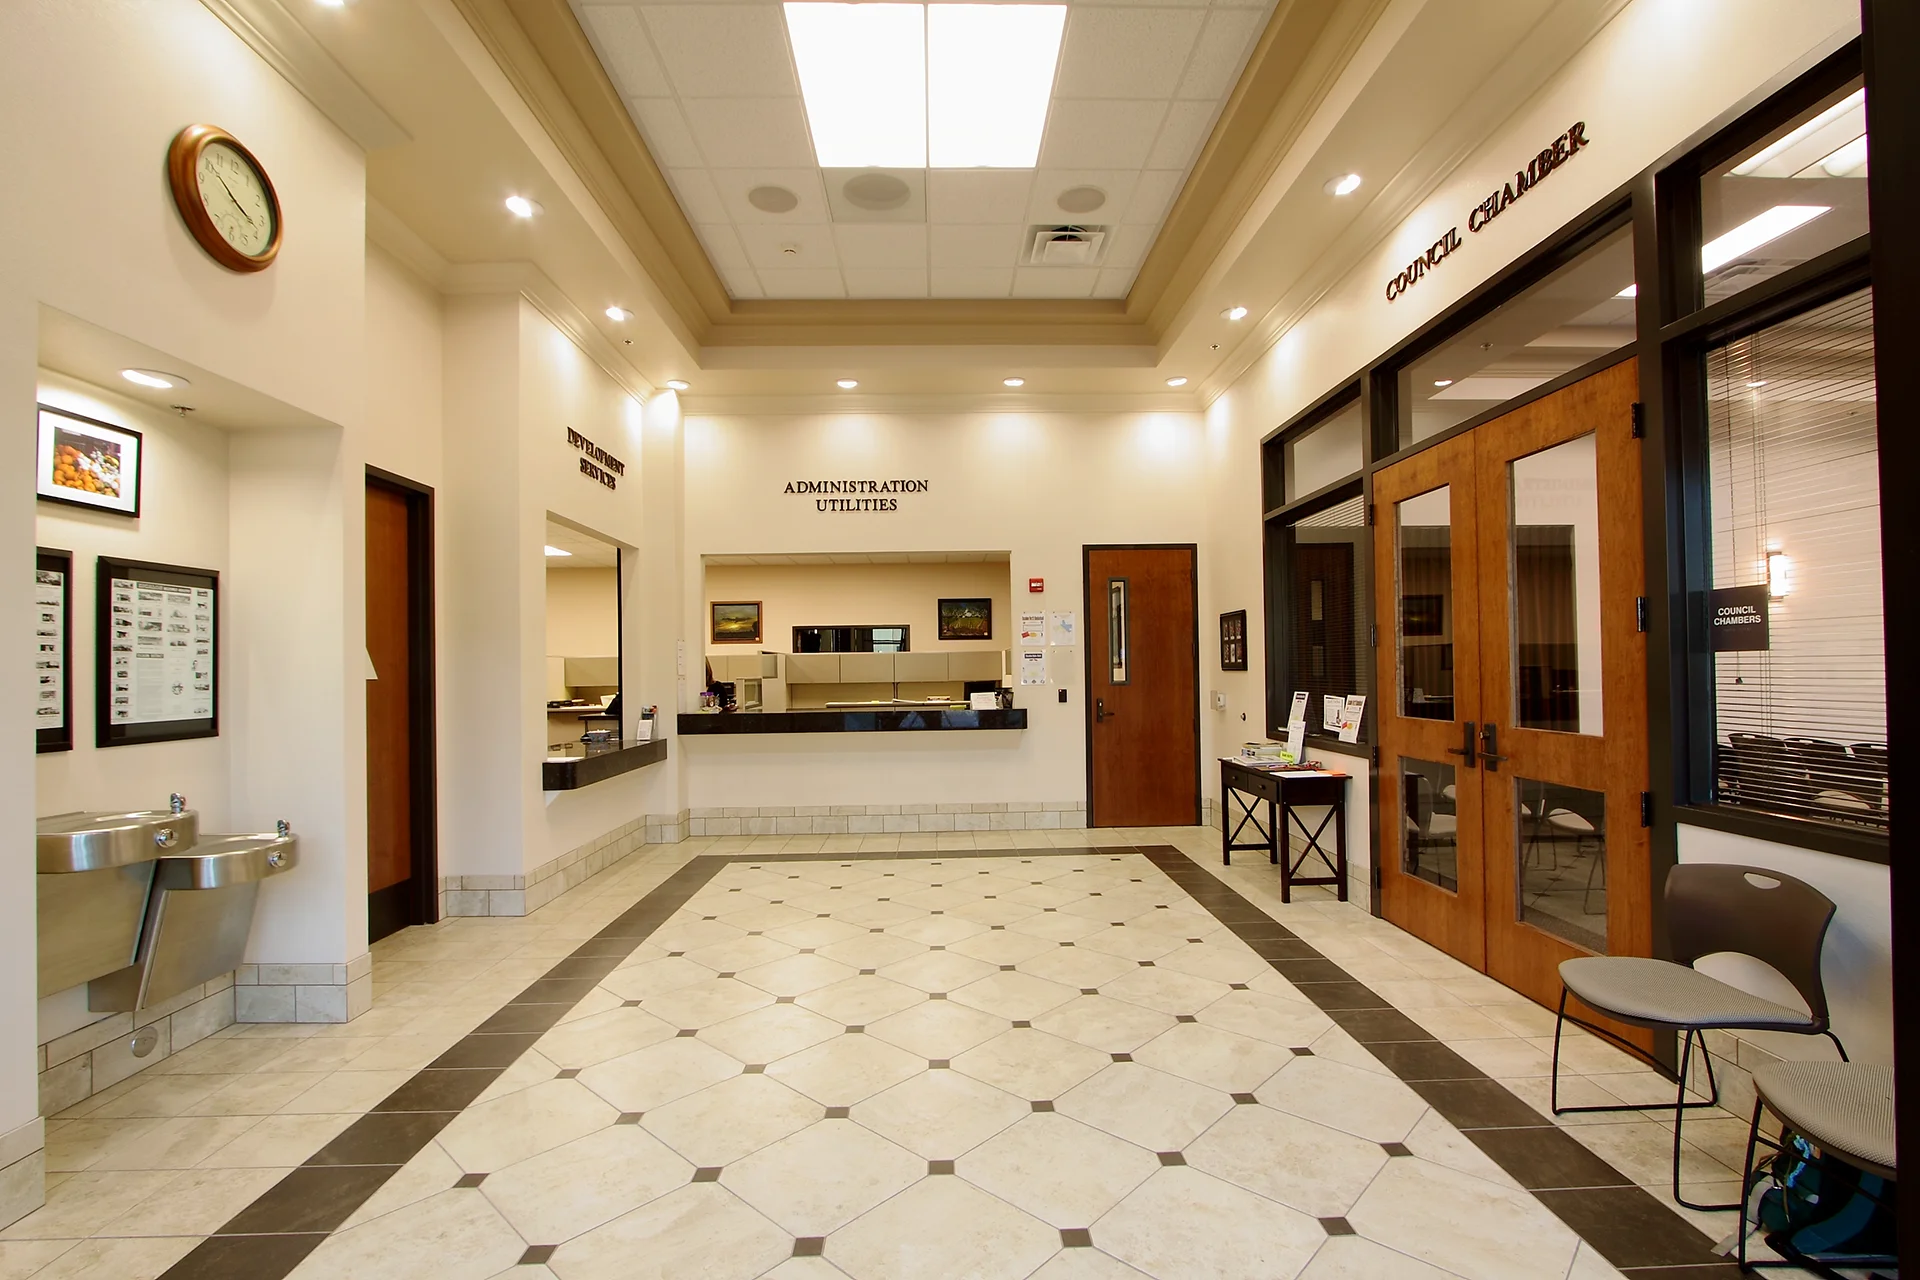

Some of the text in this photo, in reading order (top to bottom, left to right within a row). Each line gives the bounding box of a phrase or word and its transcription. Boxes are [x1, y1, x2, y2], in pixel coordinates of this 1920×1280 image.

[230, 159, 239, 175] 12
[255, 194, 261, 208] 2
[1386, 121, 1590, 300] COUNCIL CHAMBER
[567, 426, 625, 476] DEVELOPMENT
[580, 457, 616, 490] SERVICES
[784, 480, 929, 493] ADMINISTRATION
[816, 499, 898, 512] UTILITIES
[1718, 606, 1756, 616] COUNCIL
[1713, 615, 1762, 626] CHAMBERS
